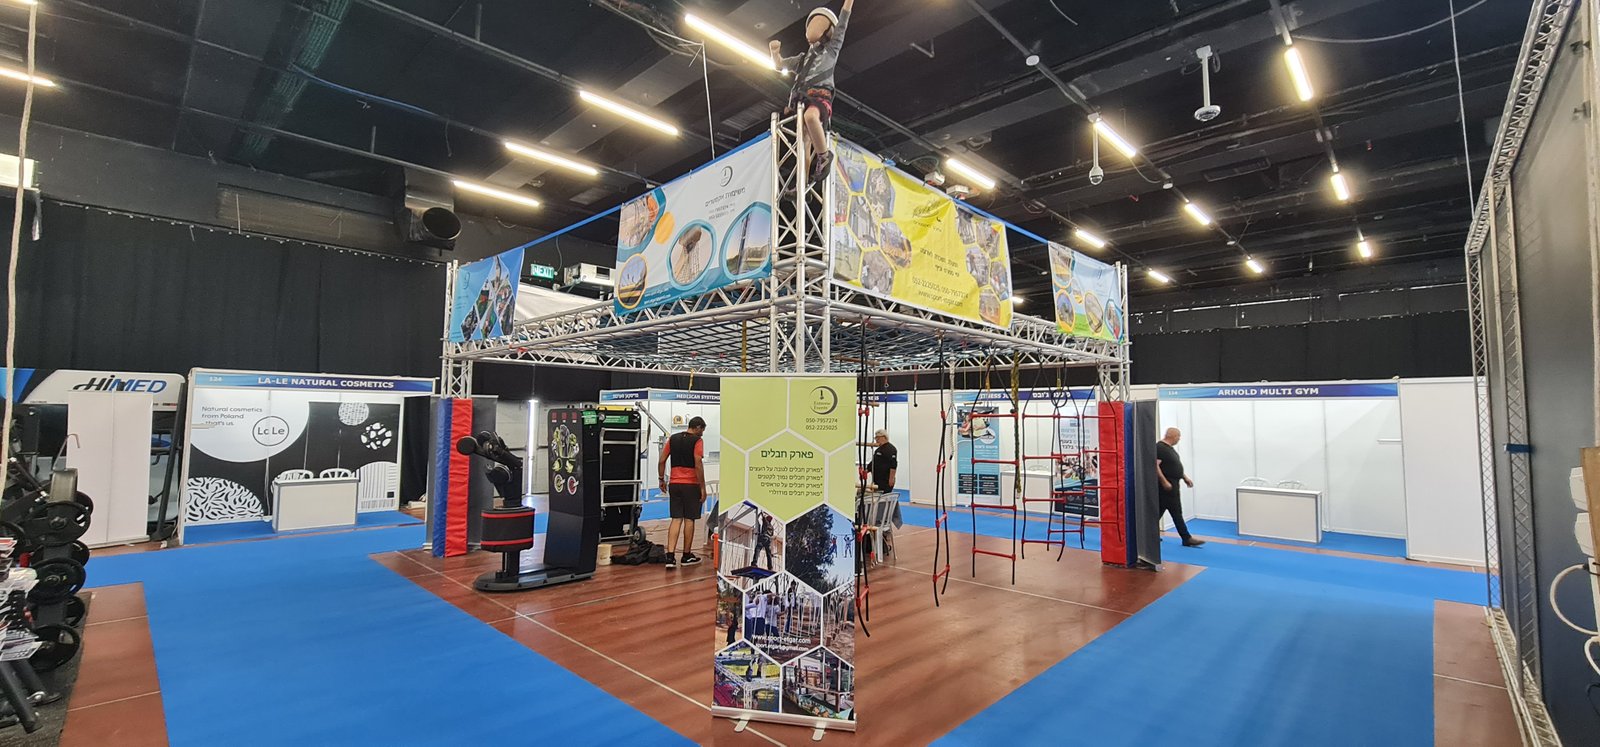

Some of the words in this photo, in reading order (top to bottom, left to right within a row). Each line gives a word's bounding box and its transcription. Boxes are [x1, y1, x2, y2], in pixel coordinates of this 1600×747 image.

[257, 377, 288, 385] LA-LE
[291, 378, 338, 387] NATURAL
[340, 379, 395, 389] COSMETICS
[1217, 388, 1257, 396] ARNOLD
[1295, 387, 1319, 395] GYM
[271, 426, 285, 435] Le
[760, 448, 788, 458] חבלים
[789, 450, 814, 460] פארק
